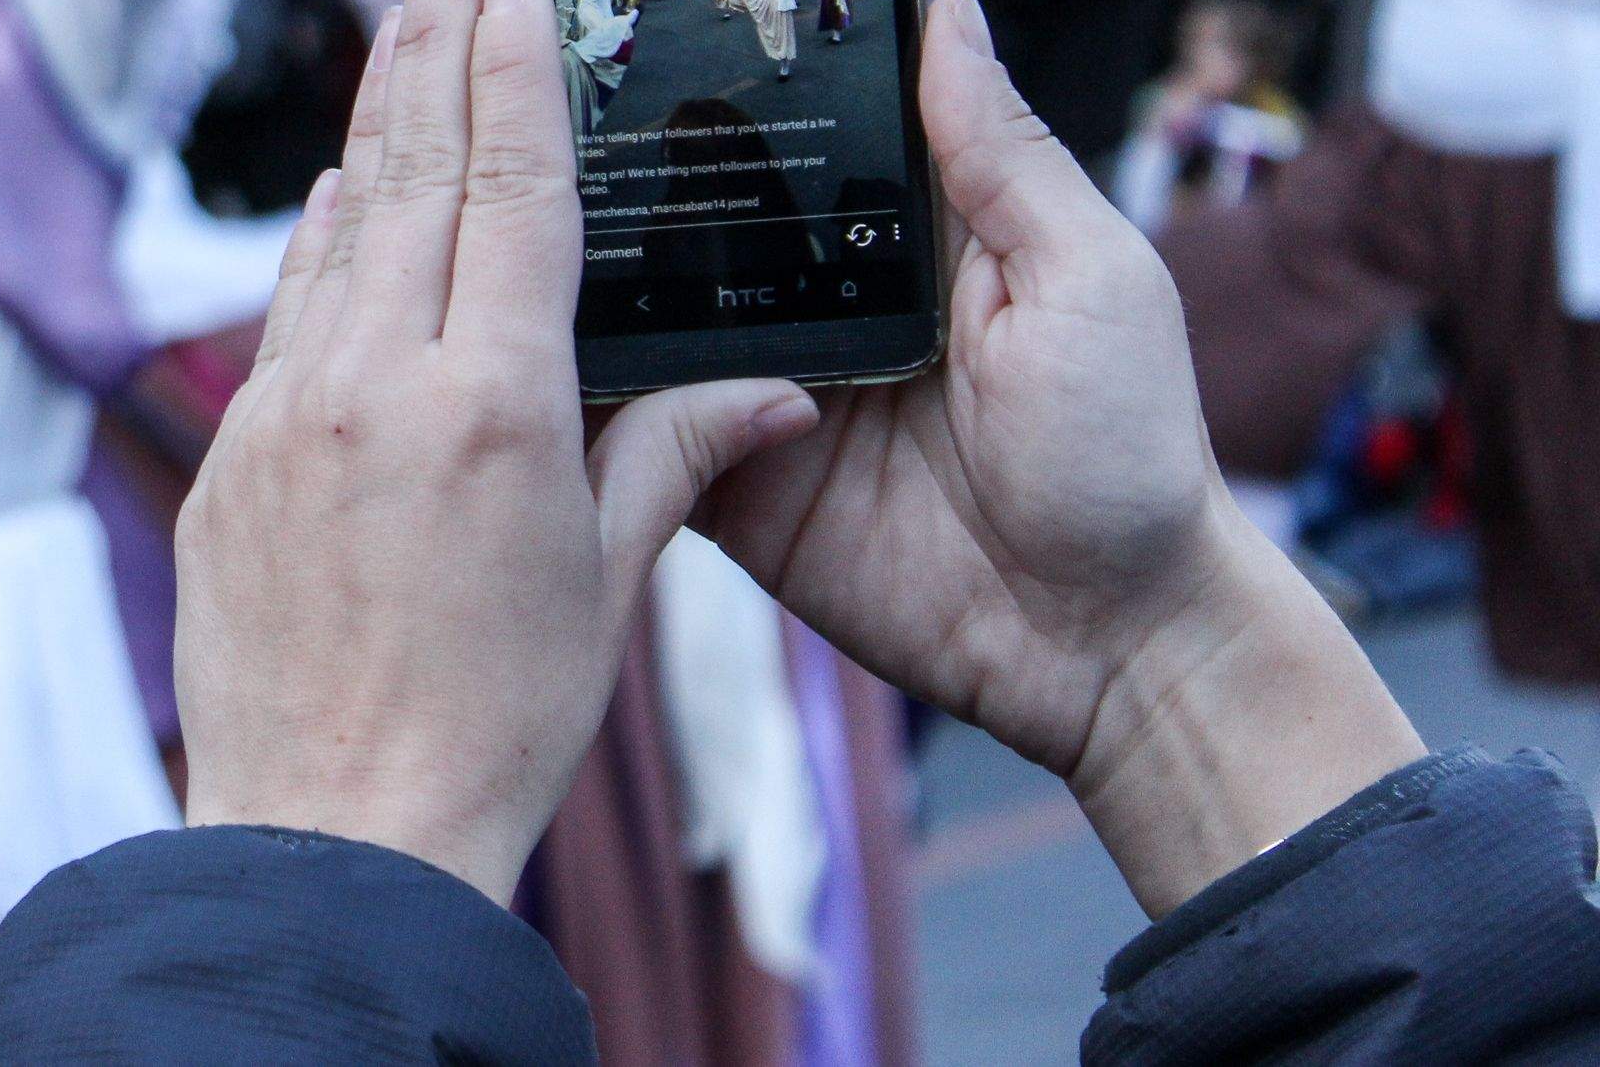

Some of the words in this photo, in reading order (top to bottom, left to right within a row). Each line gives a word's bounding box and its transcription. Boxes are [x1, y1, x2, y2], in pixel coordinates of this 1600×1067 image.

[578, 134, 605, 145] We're
[606, 131, 639, 144] telling
[640, 130, 663, 143] your
[665, 127, 713, 139] followers
[714, 125, 736, 136] that
[737, 122, 770, 136] you've
[771, 118, 808, 131] started
[809, 120, 817, 129] a
[818, 118, 837, 128] live
[580, 171, 608, 183] Hang
[609, 169, 626, 180] on!
[627, 167, 656, 179] We're
[658, 165, 690, 177] telling
[691, 164, 718, 174] more
[720, 160, 768, 172] followers
[769, 159, 781, 169] to
[782, 156, 802, 170] join
[803, 156, 827, 169] your
[580, 184, 611, 195] video.
[652, 199, 726, 214] marcsabate14
[727, 196, 760, 211] joined
[585, 246, 644, 260] Comment
